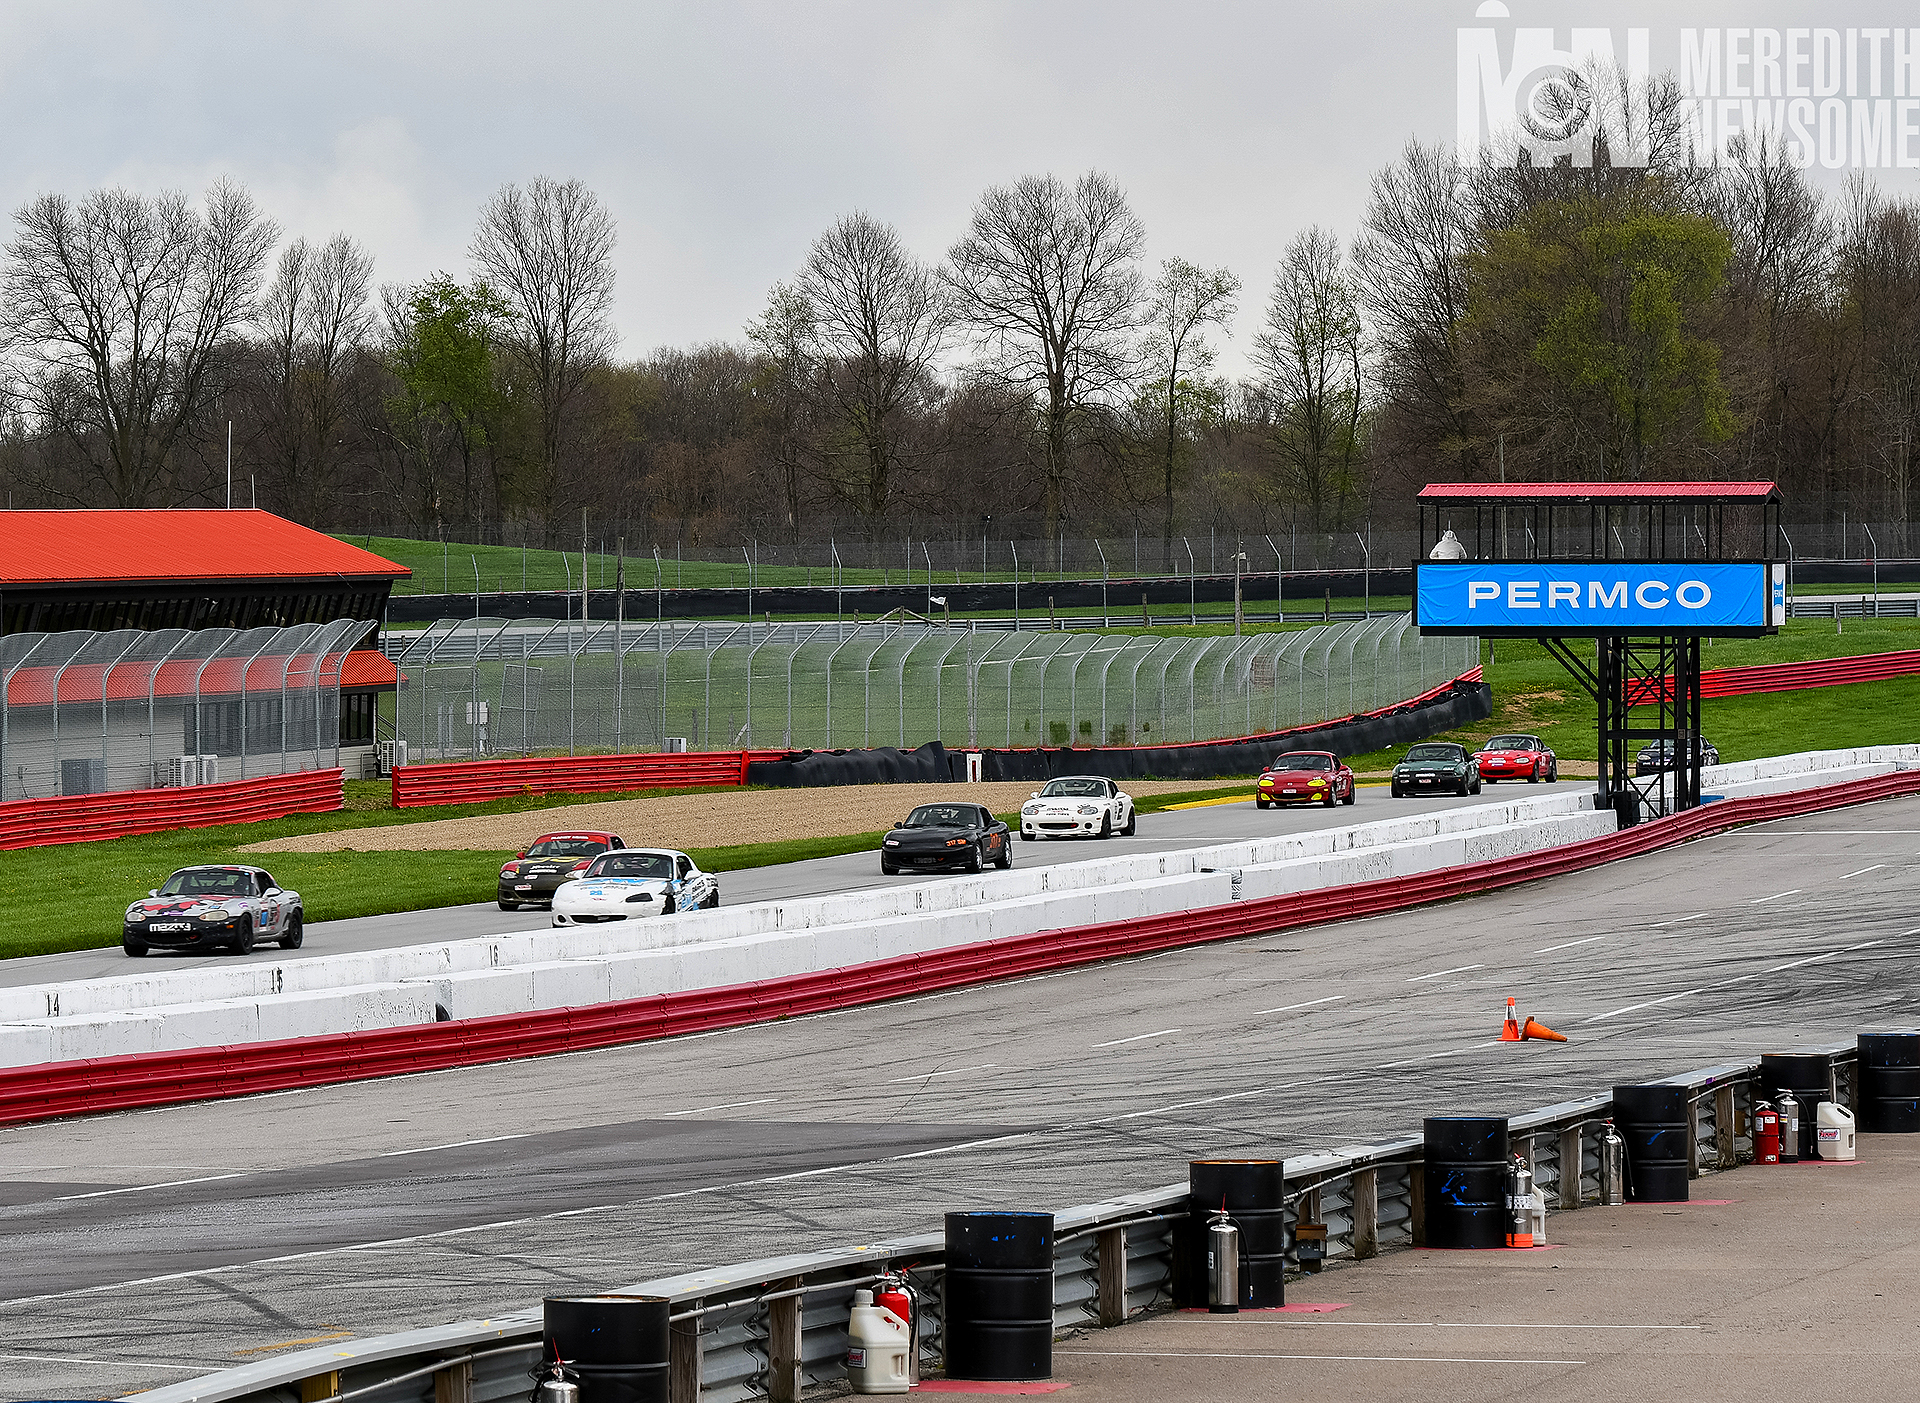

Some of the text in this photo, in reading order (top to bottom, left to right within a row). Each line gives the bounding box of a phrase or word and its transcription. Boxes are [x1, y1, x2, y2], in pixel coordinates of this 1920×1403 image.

[1468, 580, 1712, 609] PERMCO
[489, 944, 499, 967] 16
[270, 967, 283, 994] 15
[46, 993, 60, 1017] 14
